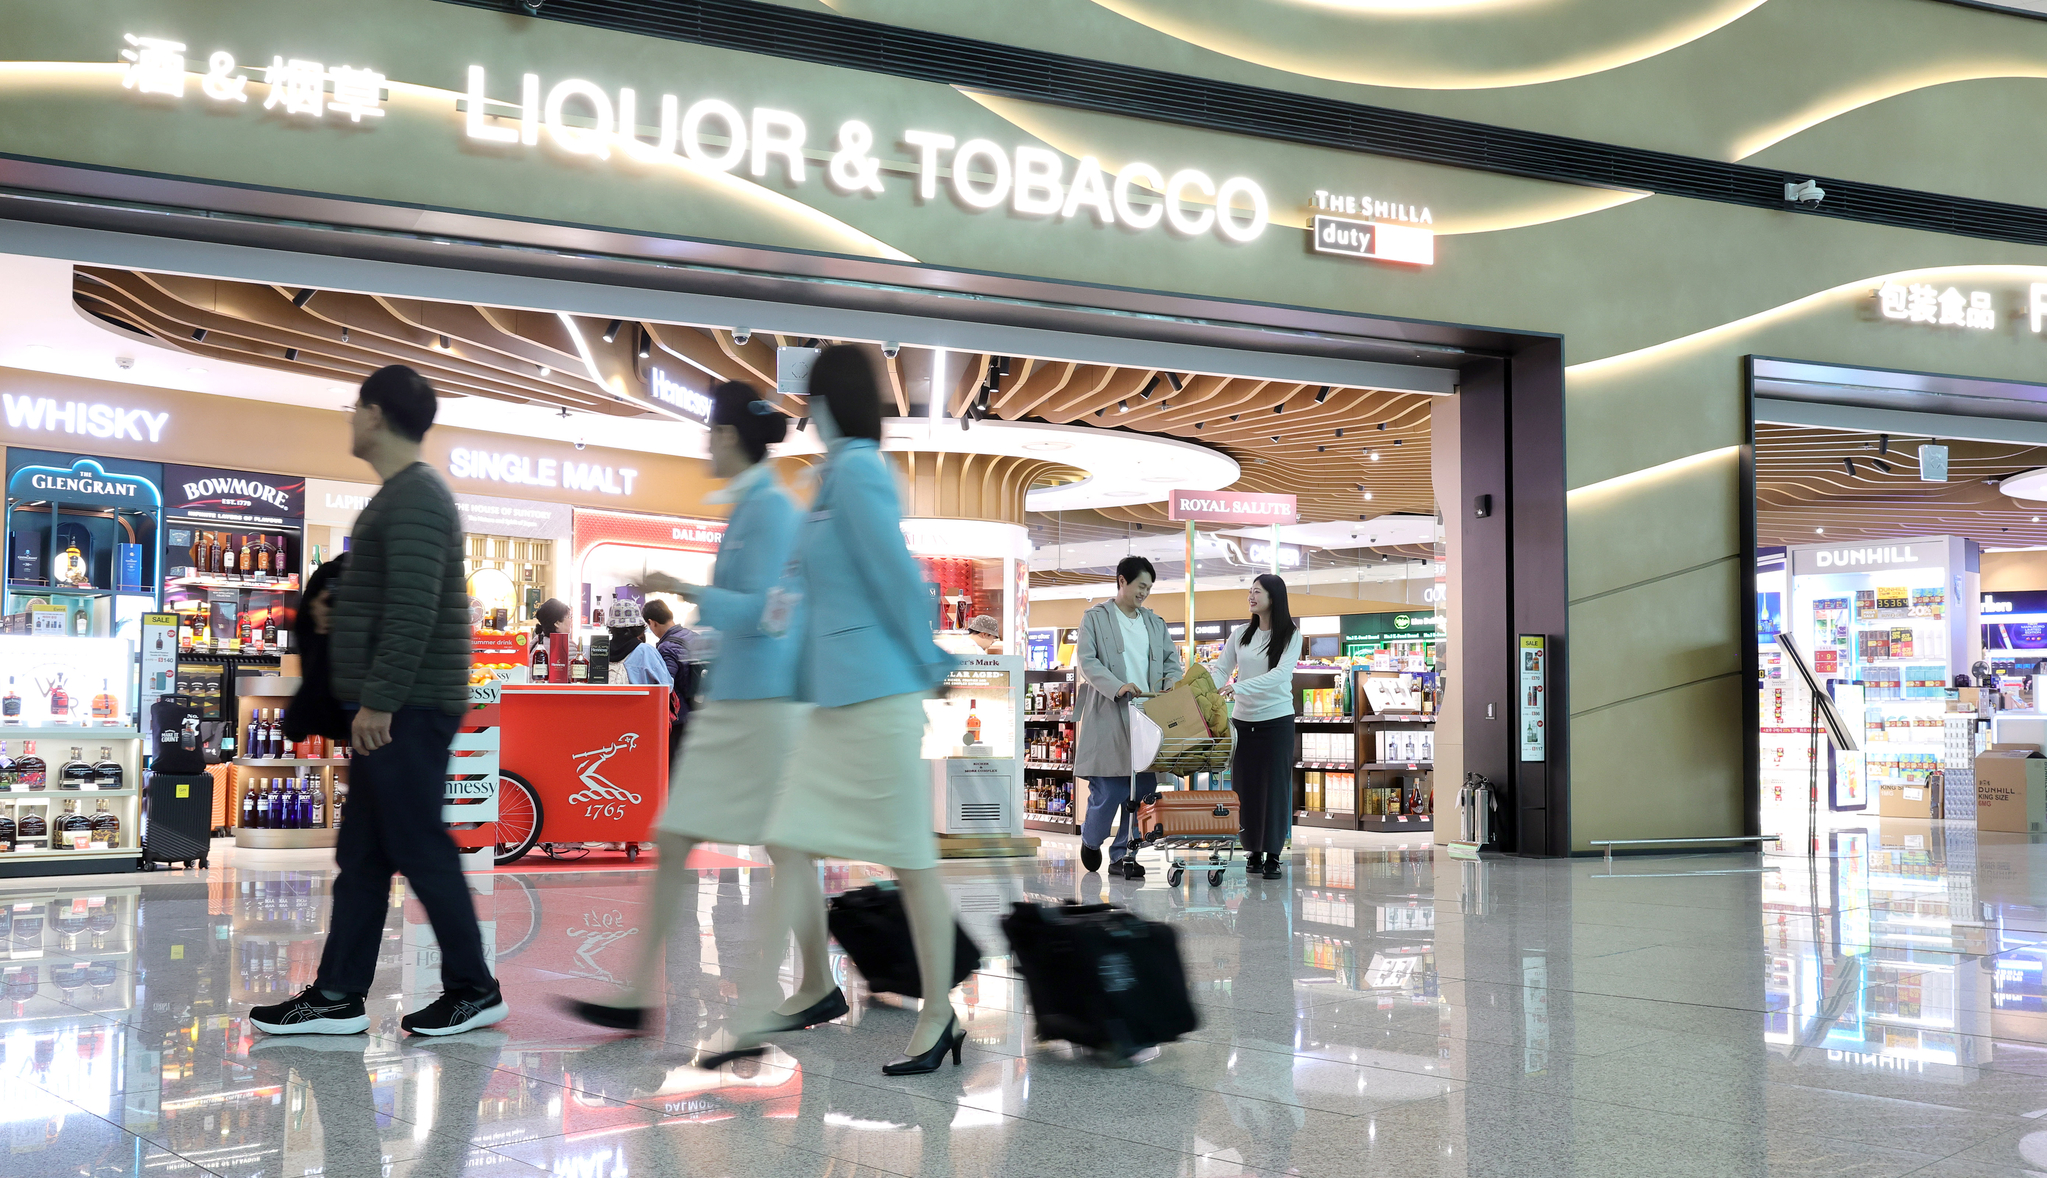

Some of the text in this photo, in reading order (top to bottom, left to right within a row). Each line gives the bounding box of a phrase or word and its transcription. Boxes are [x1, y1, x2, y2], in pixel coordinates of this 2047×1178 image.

[121, 33, 387, 121] 酒 & 烟草
[467, 65, 1271, 242] LIQUOR & TOBACCO
[1315, 190, 1433, 225] THE SHILLA
[1323, 223, 1370, 252] duty
[1879, 281, 1994, 330] 包装食品
[652, 366, 713, 423] Hennessy
[2, 393, 170, 443] WHISKY
[32, 474, 137, 497] GLENGRANT
[449, 447, 638, 495] SINGLE MALT
[183, 478, 289, 509] BOWMORE
[1180, 498, 1291, 516] ROYAL SALUTE
[471, 504, 500, 514] HOUSE
[501, 507, 512, 516] OF
[513, 508, 552, 520] SUNTORY
[672, 528, 725, 544] DALMOR
[1816, 546, 1918, 567] DUNHILL
[468, 688, 500, 702] essy
[444, 782, 498, 798] nnessy
[584, 804, 626, 820] 1765
